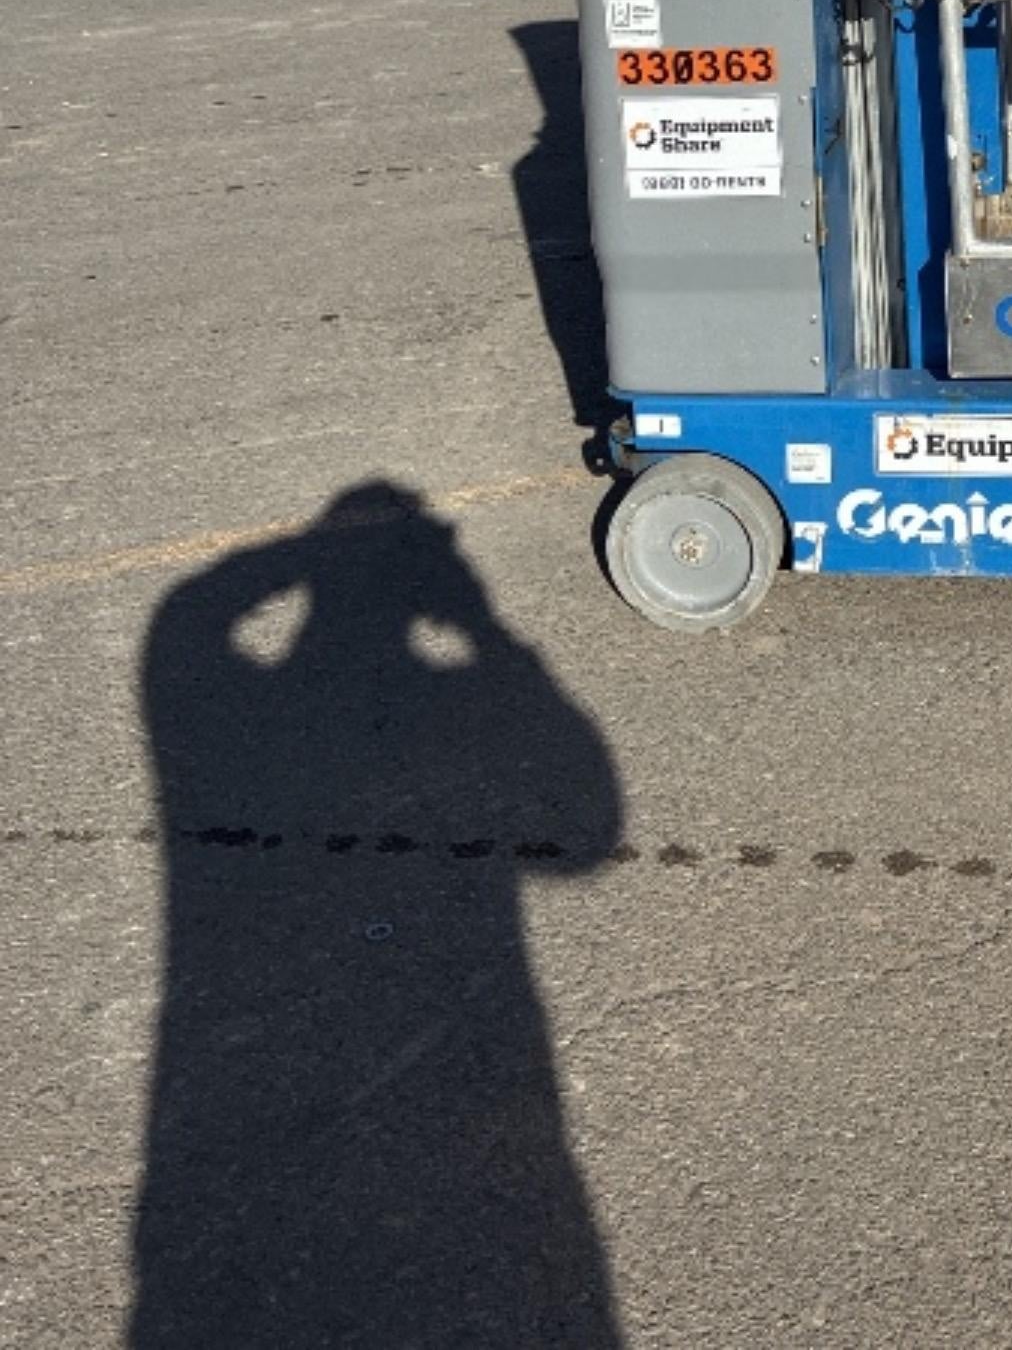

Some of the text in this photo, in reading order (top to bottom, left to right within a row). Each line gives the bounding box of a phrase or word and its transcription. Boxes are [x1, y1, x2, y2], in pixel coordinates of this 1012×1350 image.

[619, 48, 773, 86] 330363
[660, 116, 775, 138] Equipment
[662, 137, 721, 154] Share
